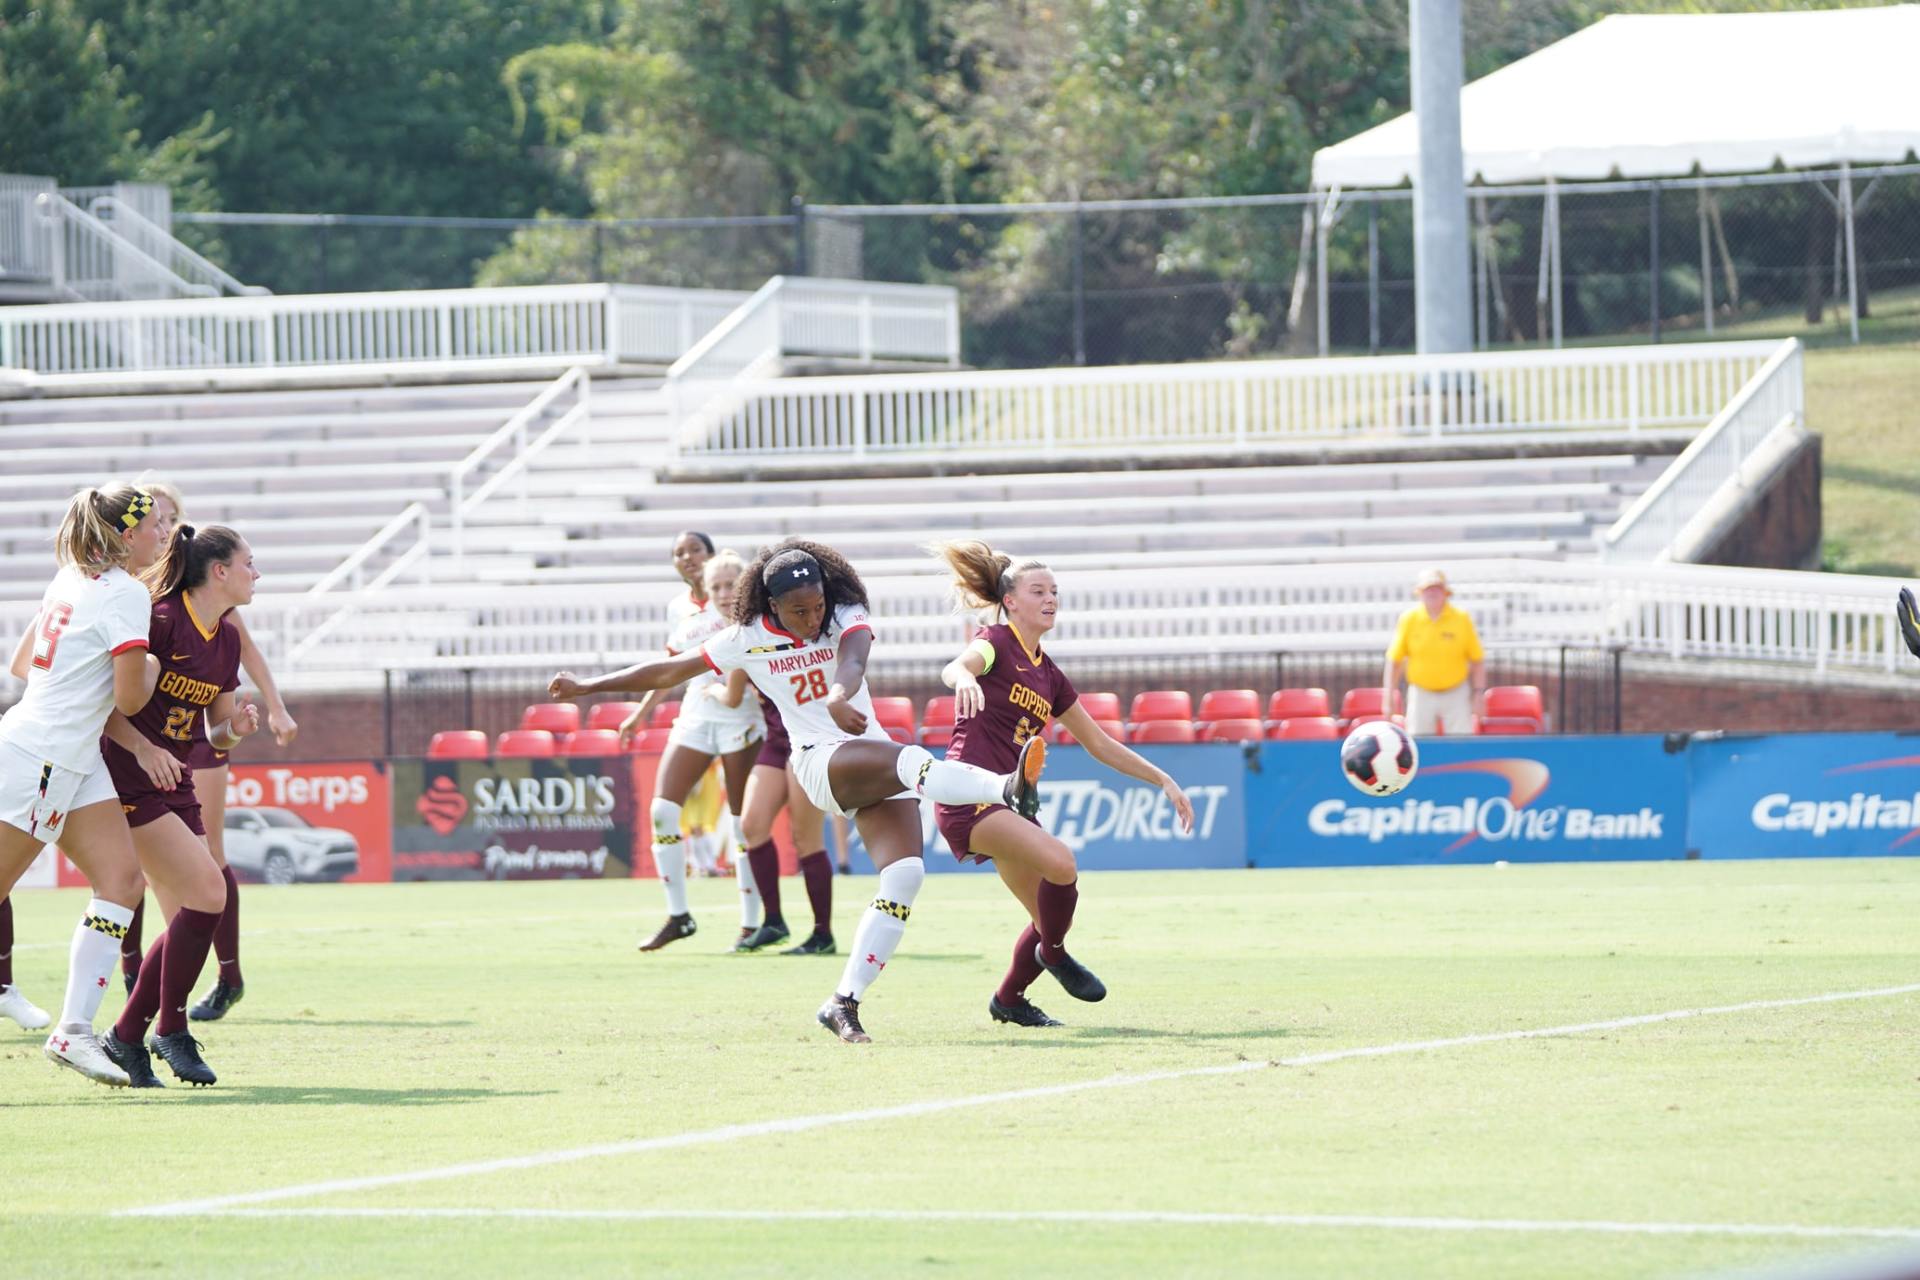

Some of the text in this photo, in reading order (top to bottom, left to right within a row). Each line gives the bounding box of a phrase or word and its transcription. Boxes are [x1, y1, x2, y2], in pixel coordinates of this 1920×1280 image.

[768, 648, 834, 675] MARYLAND
[159, 671, 222, 705] GOPHER
[790, 668, 829, 706] 28
[266, 769, 369, 812] Terps
[474, 775, 615, 815] SARDI'S
[1564, 807, 1664, 840] Bank
[1751, 792, 1920, 838] Capital
